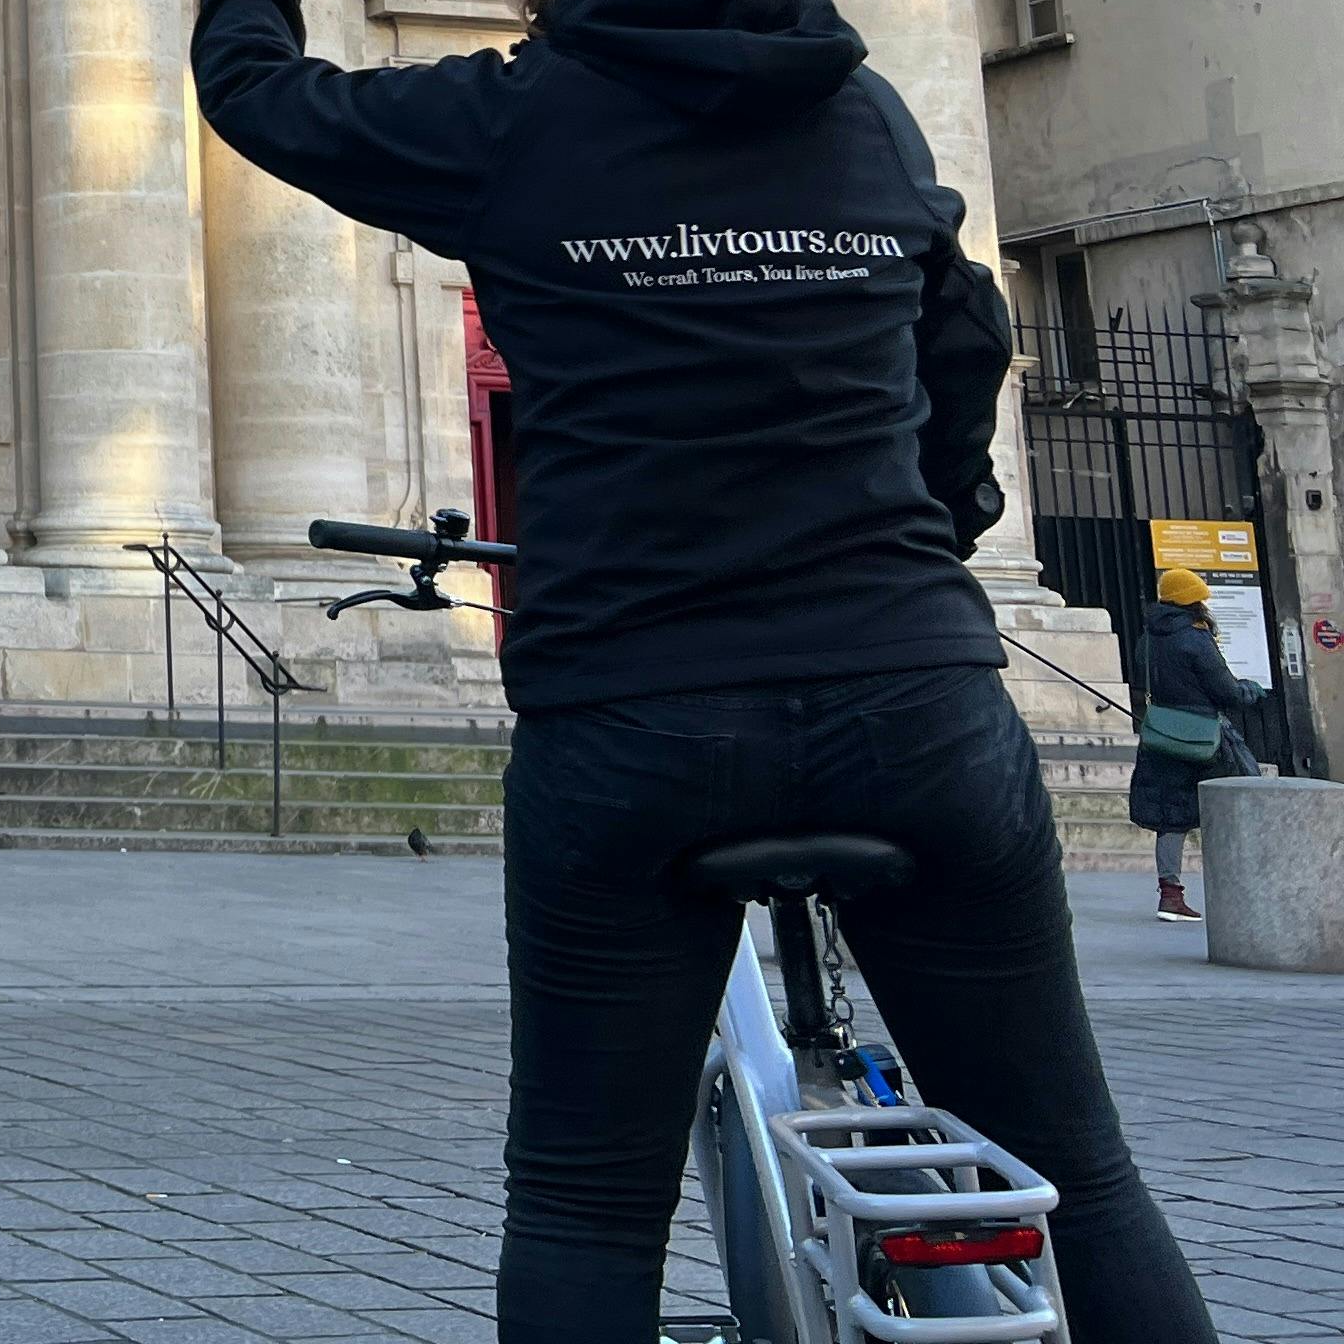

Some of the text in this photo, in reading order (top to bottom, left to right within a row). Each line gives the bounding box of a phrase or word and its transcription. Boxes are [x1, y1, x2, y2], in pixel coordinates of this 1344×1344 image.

[561, 223, 905, 263] www.livtours.com
[623, 264, 870, 287] We craft Tours, You live them
